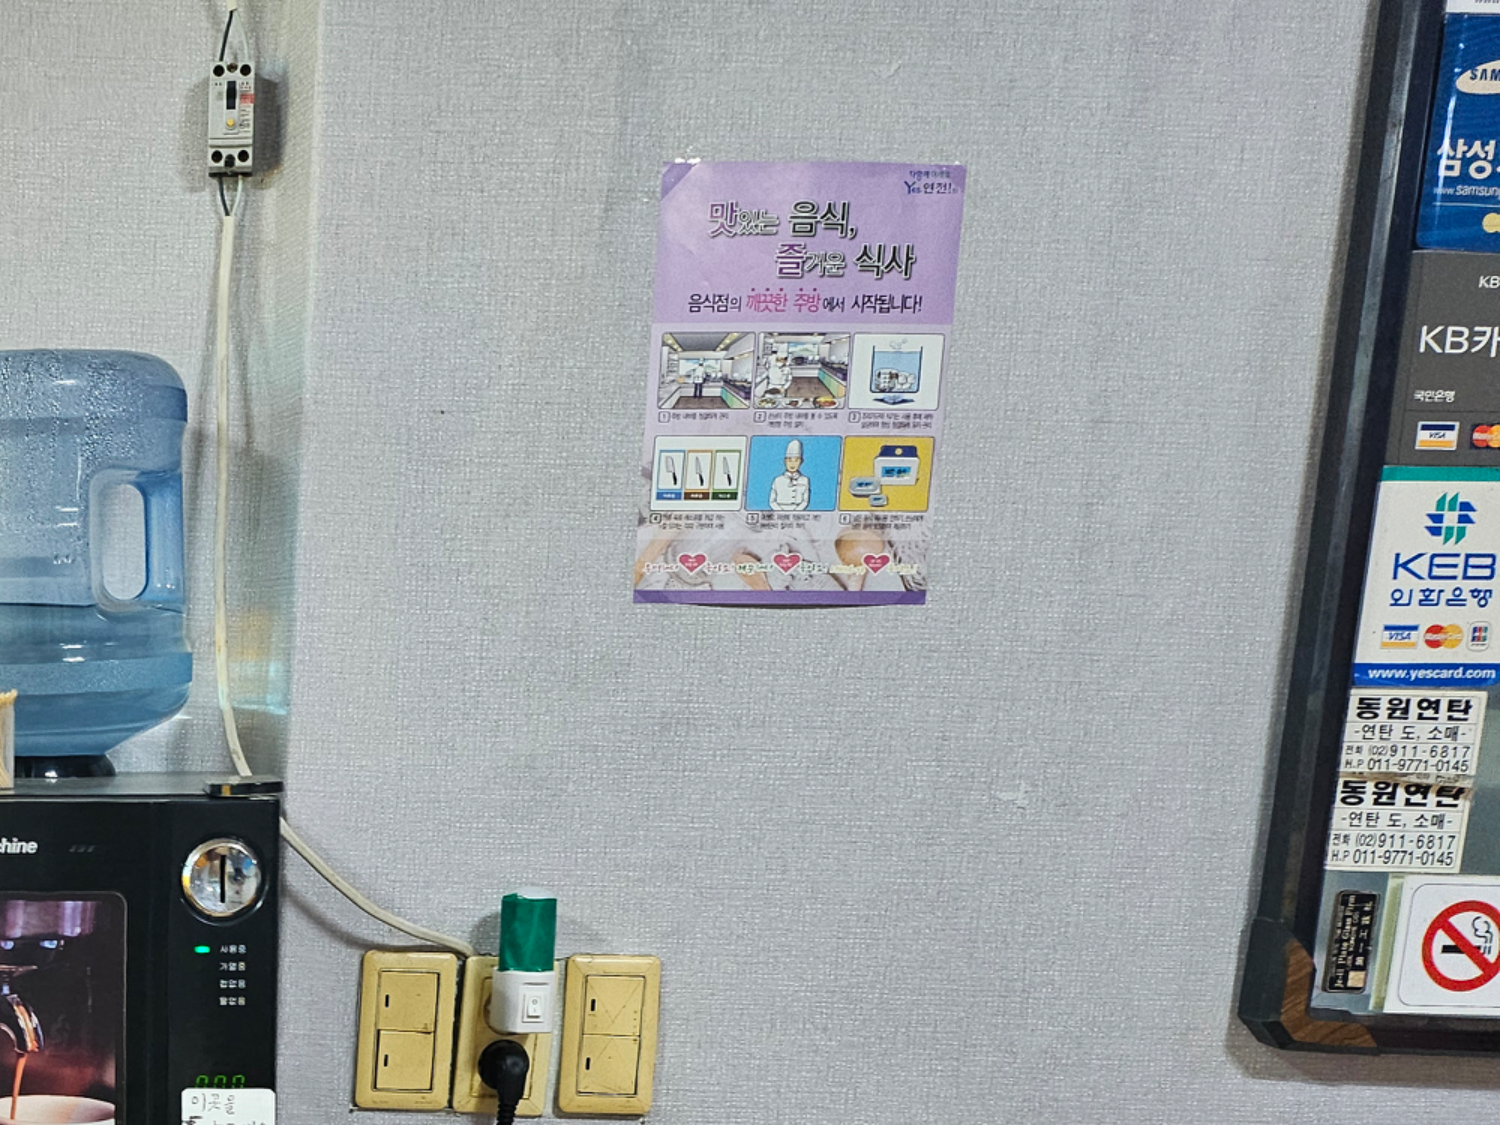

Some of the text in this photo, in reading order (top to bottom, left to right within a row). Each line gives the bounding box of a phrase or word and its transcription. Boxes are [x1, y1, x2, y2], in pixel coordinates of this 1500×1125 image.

[1437, 138, 1500, 180] 삼성
[709, 200, 858, 239] 맛있는 음식,
[775, 243, 916, 279] 즐거운 식사
[688, 293, 742, 314] 음식점의
[746, 293, 788, 314] 깨끗한
[851, 294, 923, 314] 시작됩니다!
[1392, 552, 1497, 581] KEB
[1389, 586, 1494, 608] 외환은행
[1388, 632, 1411, 641] VISA
[1367, 667, 1497, 681] www.yescard.com
[1356, 697, 1473, 722] 동원연탄
[1368, 744, 1471, 758] (02)911-6817
[1344, 758, 1469, 773] H.P 011-9771-0145
[1340, 780, 1466, 808] 동원연탄
[1355, 833, 1457, 850] (02)911-6817
[1331, 849, 1454, 866] H.P 011-9771-0145
[220, 944, 247, 954] 사용중
